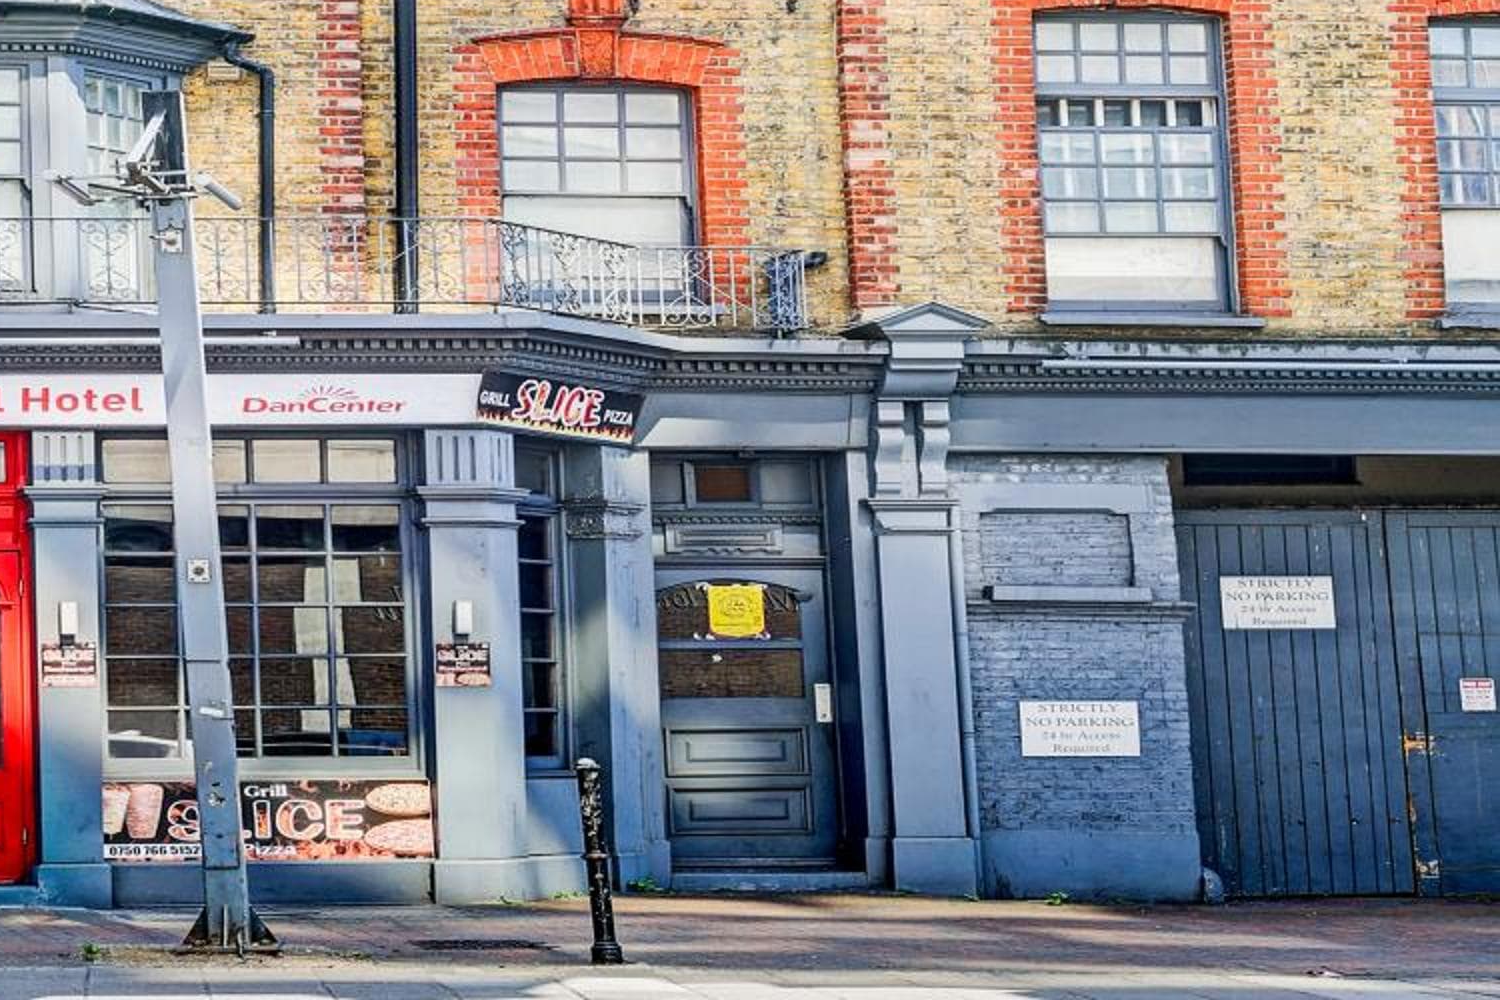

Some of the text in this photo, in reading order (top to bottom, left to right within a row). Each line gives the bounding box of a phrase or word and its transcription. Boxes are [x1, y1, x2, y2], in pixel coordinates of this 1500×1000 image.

[21, 387, 144, 412] Hotel
[242, 397, 407, 414] DanCenter
[480, 379, 633, 427] GRILL SLICE PIZZA
[1237, 579, 1317, 588] STRICTLY
[1226, 591, 1330, 601] NO PARKING
[1037, 703, 1120, 713] STRICTLY
[1026, 717, 1135, 727] NO PARKING
[243, 784, 288, 797] Grill
[167, 799, 365, 841] SICE
